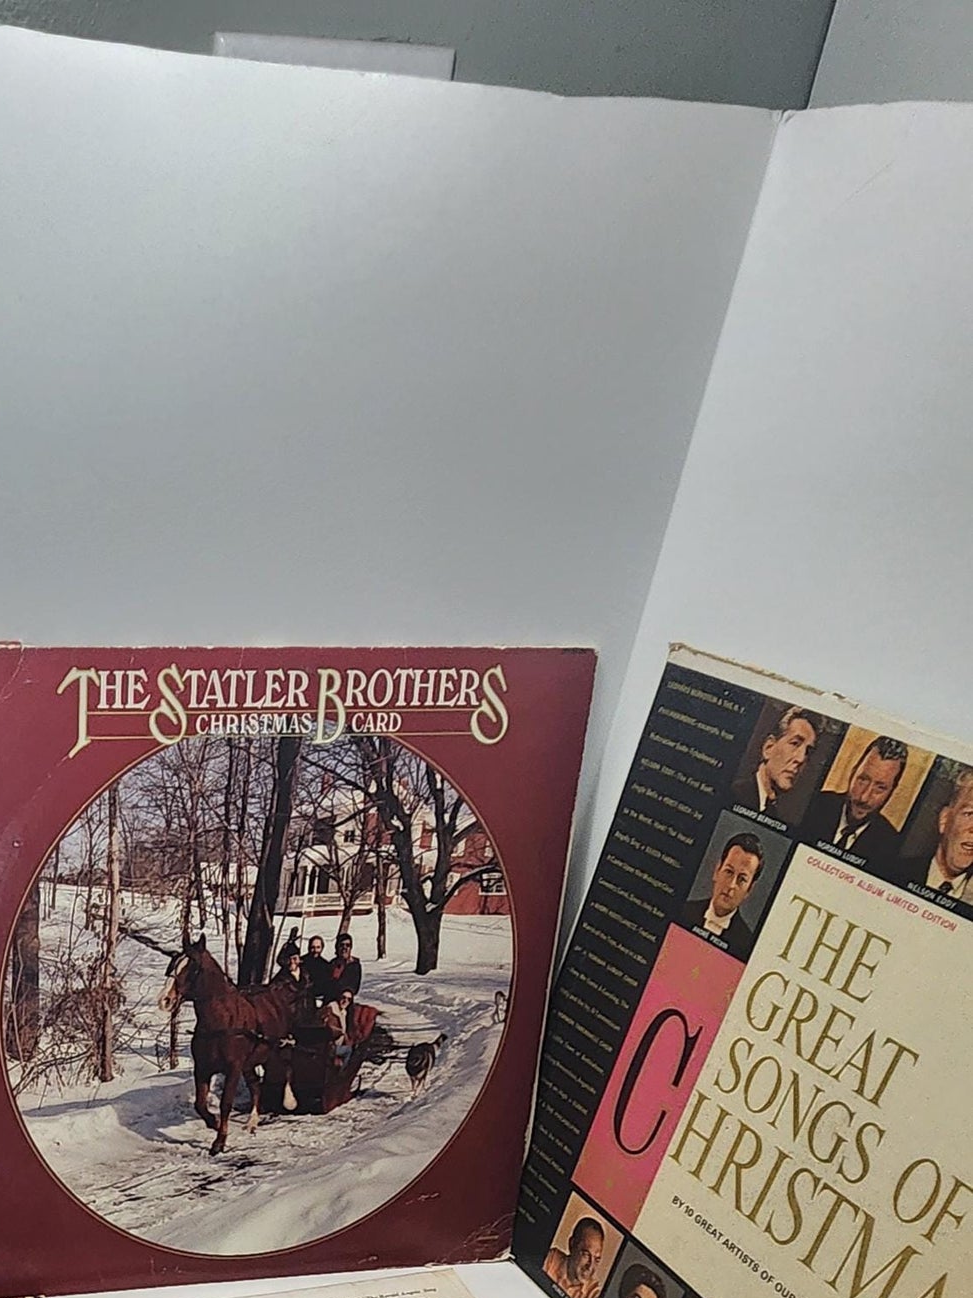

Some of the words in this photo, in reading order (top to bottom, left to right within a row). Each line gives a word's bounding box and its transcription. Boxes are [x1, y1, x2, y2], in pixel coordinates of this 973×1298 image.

[56, 665, 151, 760] THE
[149, 662, 309, 746] STATLER
[314, 663, 510, 746] BROTHERS
[194, 713, 313, 736] CHRISTMAS
[350, 712, 402, 734] CARD
[806, 855, 856, 885] COLLECTORS
[857, 878, 885, 899] ALBUM
[886, 890, 920, 914] LIMITED
[920, 908, 958, 933] EDITION
[776, 894, 892, 1004] THE
[745, 969, 920, 1110] GREAT
[714, 1036, 886, 1184] SONGS
[892, 1158, 973, 1246] OF
[671, 1195, 685, 1209] BY
[683, 1204, 695, 1218] 10
[694, 1213, 724, 1242] GREAT
[721, 1238, 760, 1273] ARTISTS
[760, 1270, 775, 1285] OF
